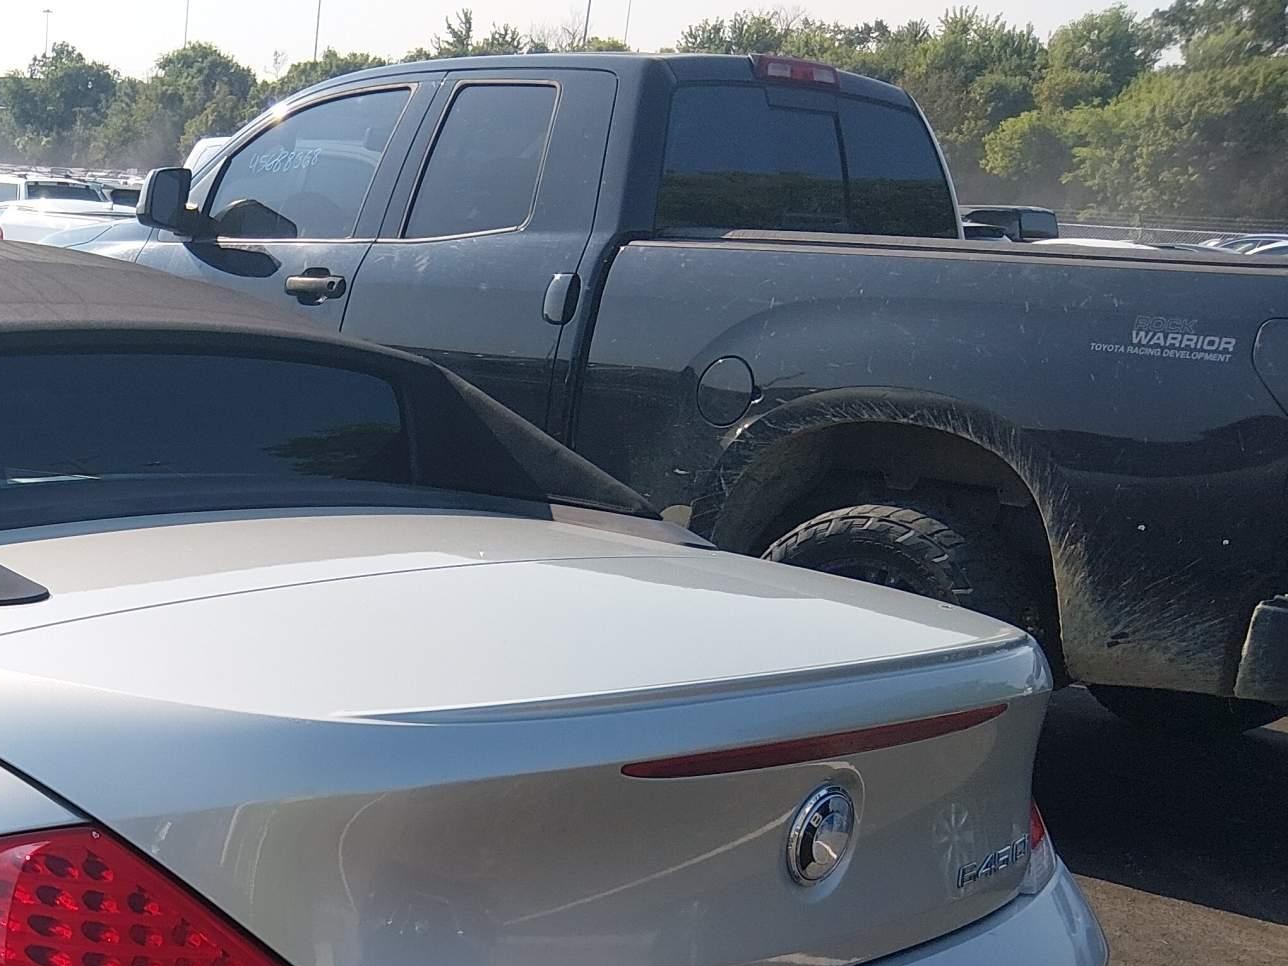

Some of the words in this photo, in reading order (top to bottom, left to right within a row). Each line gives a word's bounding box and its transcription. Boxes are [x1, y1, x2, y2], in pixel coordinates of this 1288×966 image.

[1133, 315, 1198, 333] ROCK
[1132, 330, 1236, 352] WARRIOR
[1090, 342, 1125, 353] TOYOTA
[1127, 345, 1161, 357] RACING
[1162, 349, 1232, 362] DEVELOPMENT
